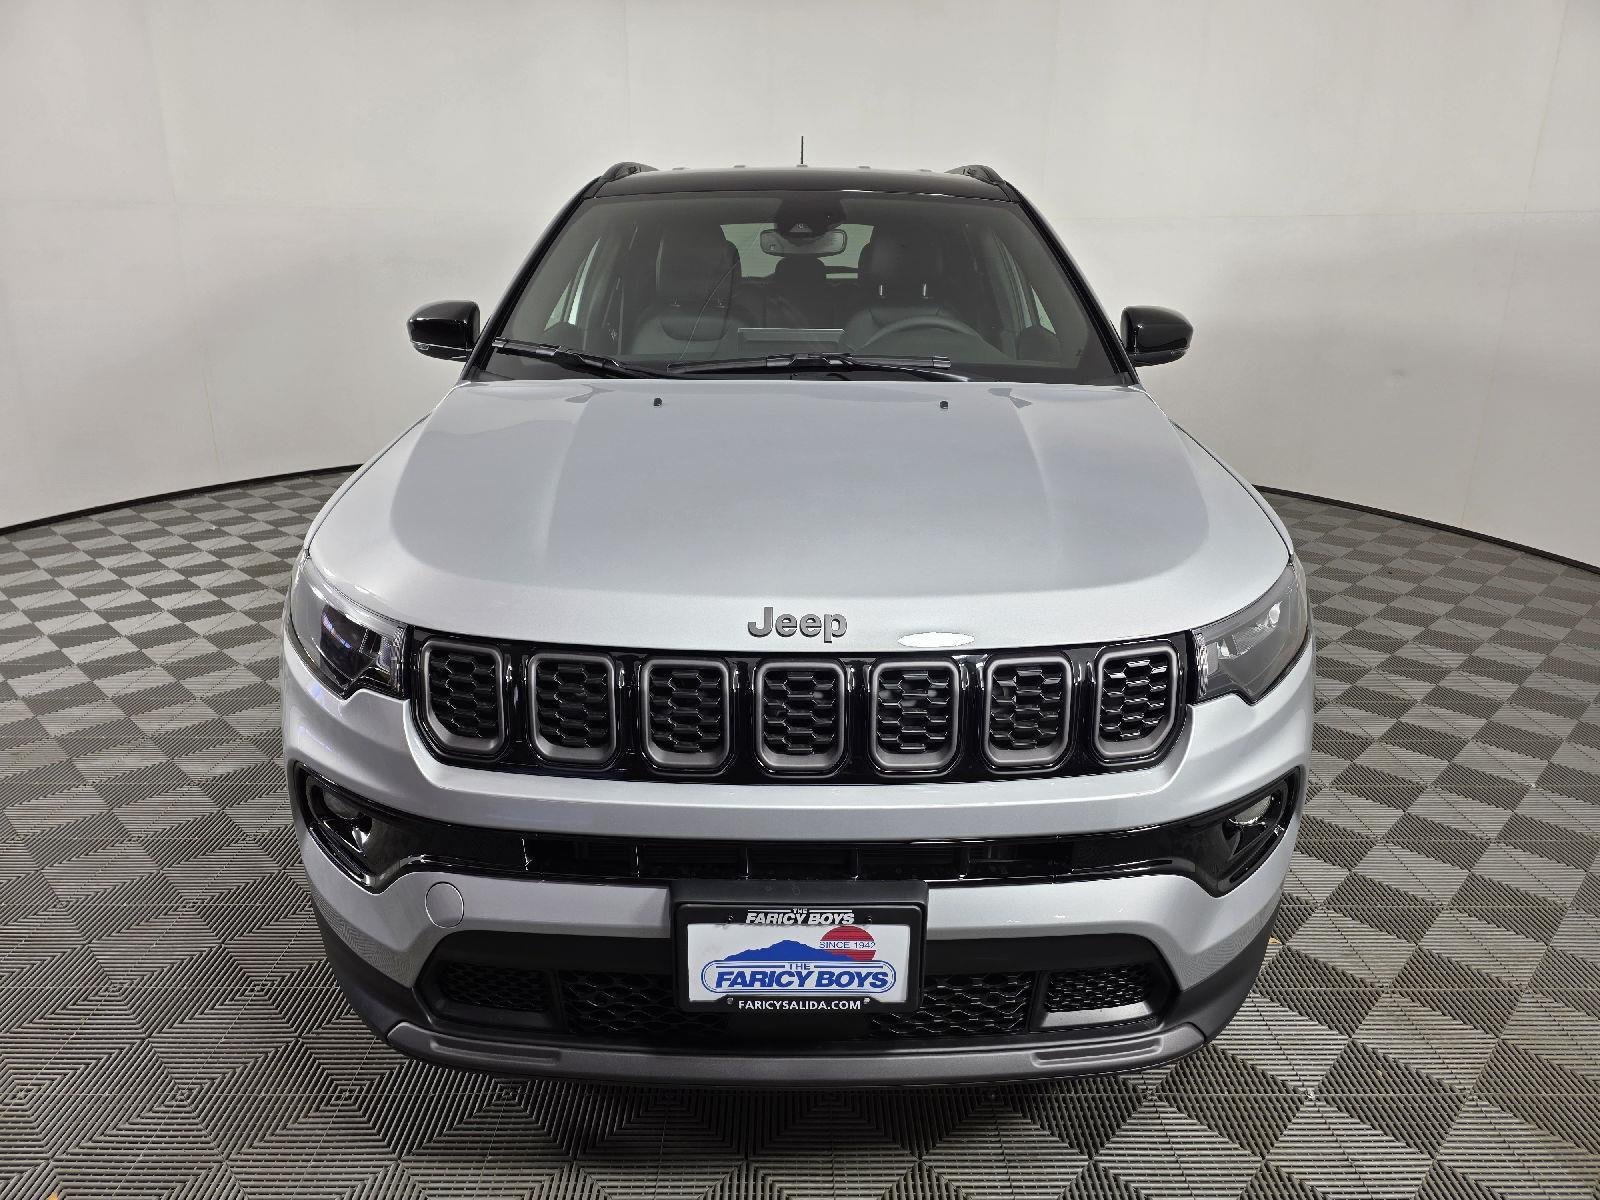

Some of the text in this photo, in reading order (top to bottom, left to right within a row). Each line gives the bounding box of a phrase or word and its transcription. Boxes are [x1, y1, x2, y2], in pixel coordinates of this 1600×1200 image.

[747, 606, 848, 643] Jeep
[745, 913, 855, 925] FARICY BOYS
[819, 941, 876, 949] SINCE 1942
[787, 963, 811, 971] THE
[715, 970, 889, 988] FARICY BOYS
[738, 1000, 861, 1010] FARICYSALIDA.COM
